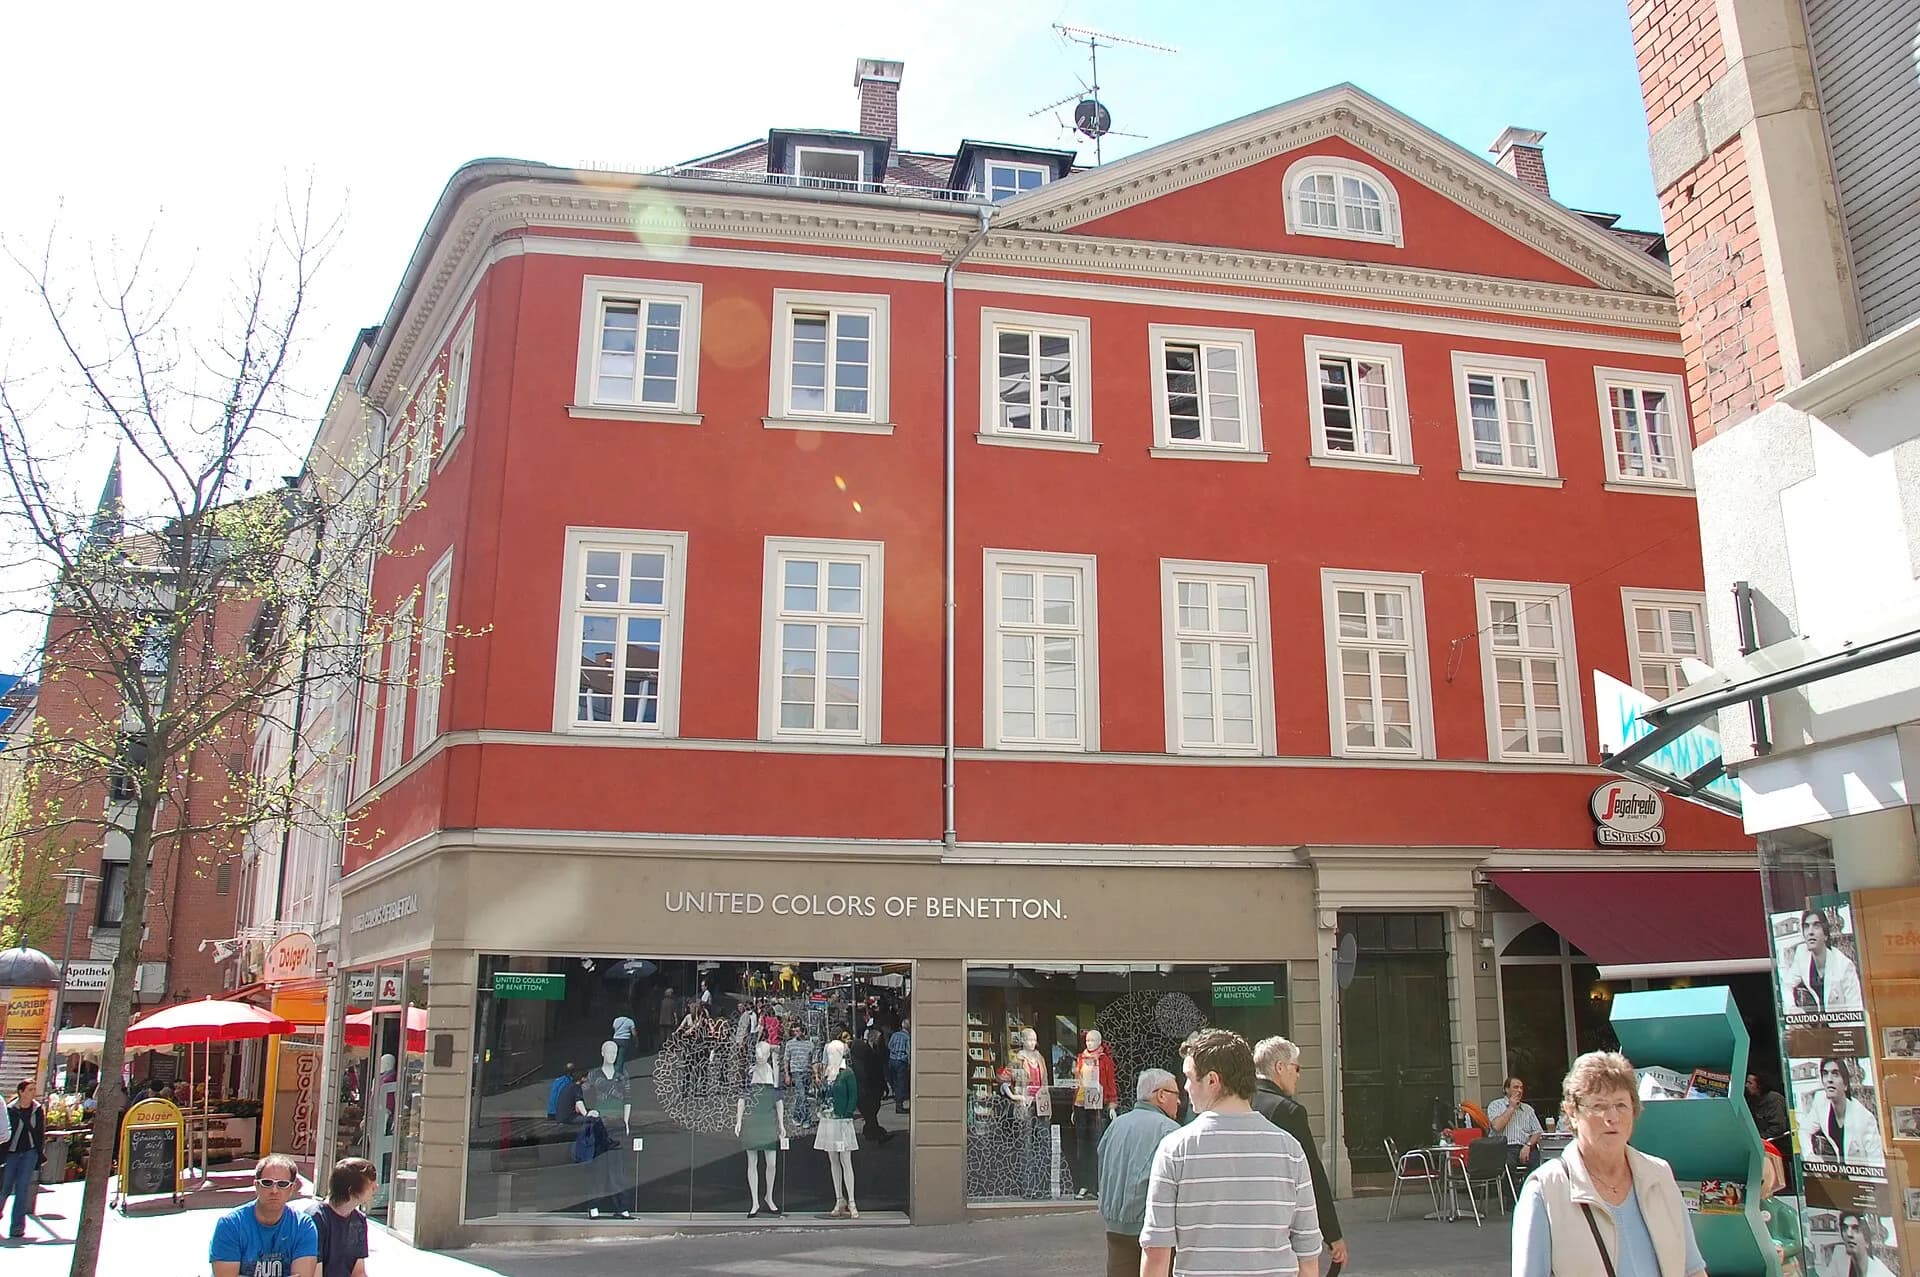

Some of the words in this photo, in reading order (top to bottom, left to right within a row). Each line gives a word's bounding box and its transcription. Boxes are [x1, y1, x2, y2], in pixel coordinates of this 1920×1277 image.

[1602, 788, 1656, 820] Segafredo
[1602, 830, 1661, 842] ESPRESSO
[665, 891, 764, 914] UNITED
[772, 894, 876, 916] COLORS
[885, 896, 918, 917] OF
[926, 897, 1068, 919] BENETTON.
[495, 976, 521, 984] UNITED
[495, 983, 504, 991] OF
[1214, 985, 1236, 993] UNITED
[1785, 1014, 1819, 1024] CLAUDIO
[1820, 1012, 1863, 1022] MOLIGNINI
[1803, 1162, 1838, 1173] CLAUDIO
[1839, 1165, 1885, 1177] MOLIGNINI
